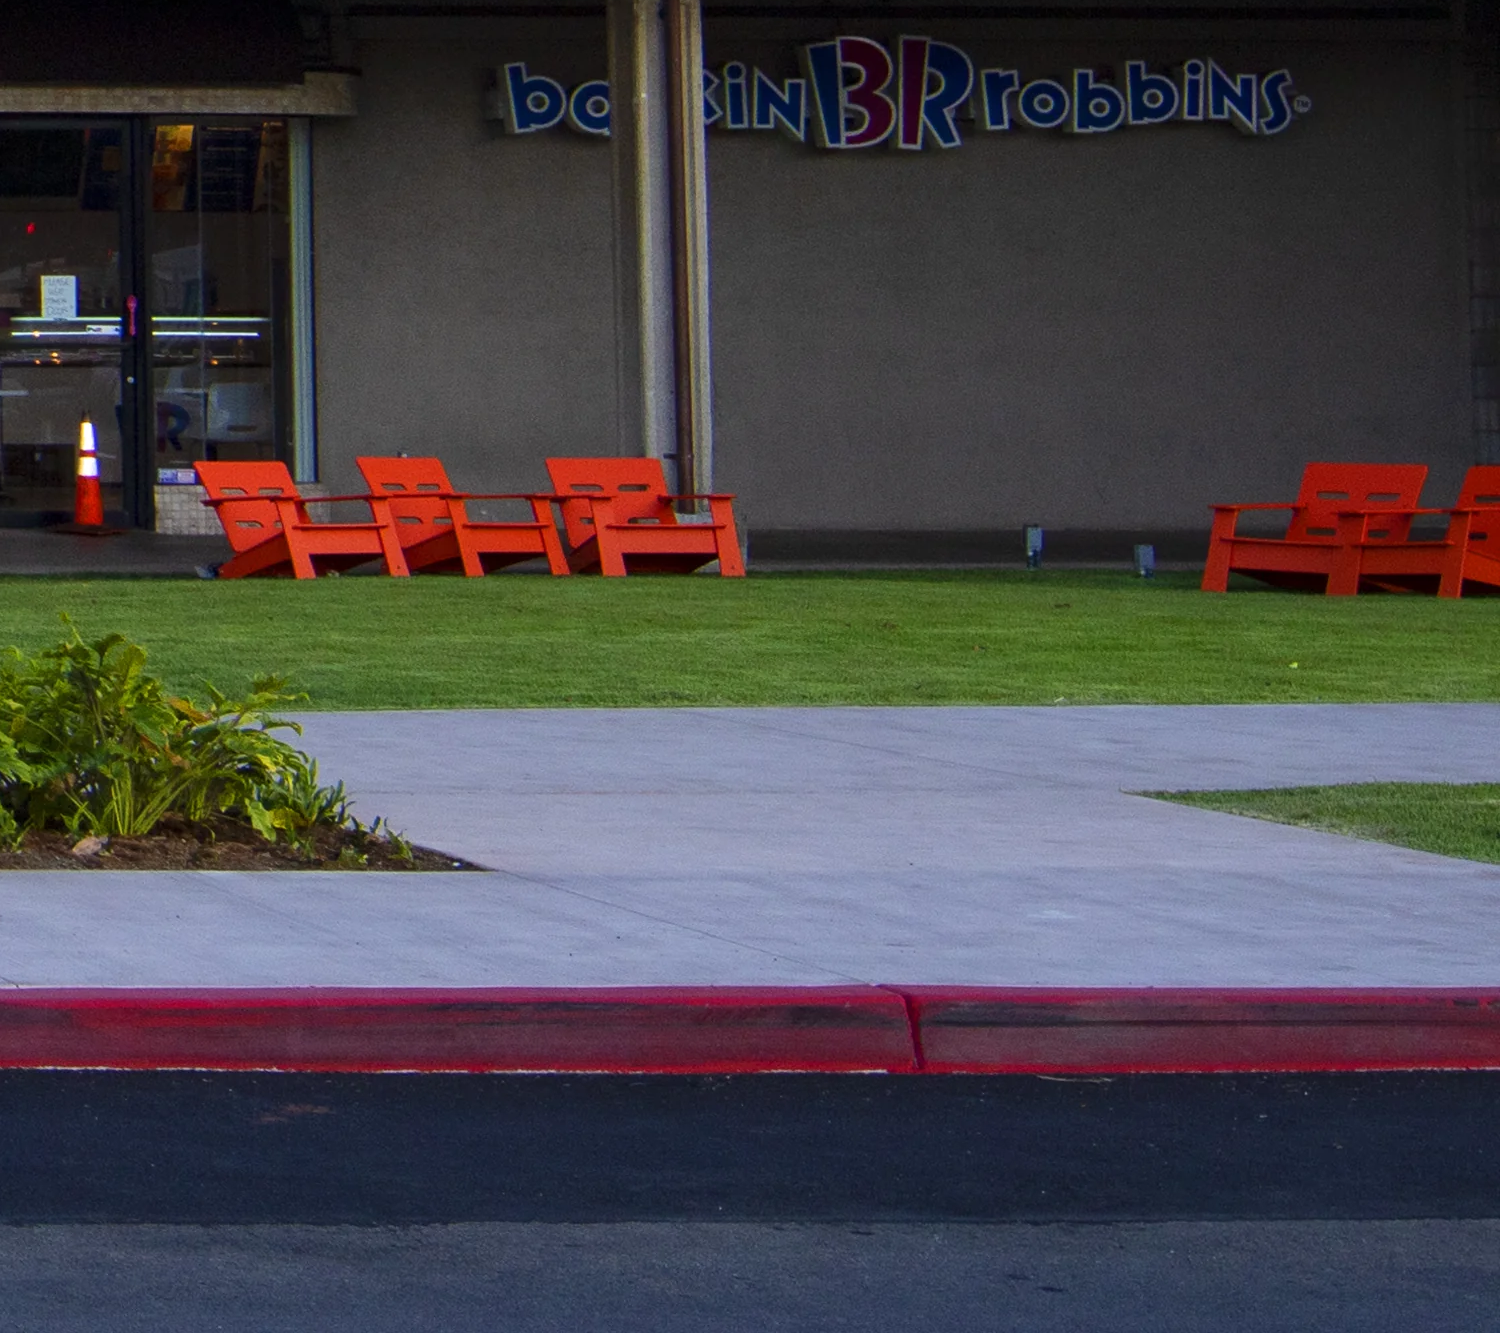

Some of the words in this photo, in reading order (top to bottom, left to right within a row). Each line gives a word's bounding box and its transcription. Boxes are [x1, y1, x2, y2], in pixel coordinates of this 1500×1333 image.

[504, 60, 807, 143] bain
[805, 35, 975, 150] BR
[979, 57, 1293, 136] robbins
